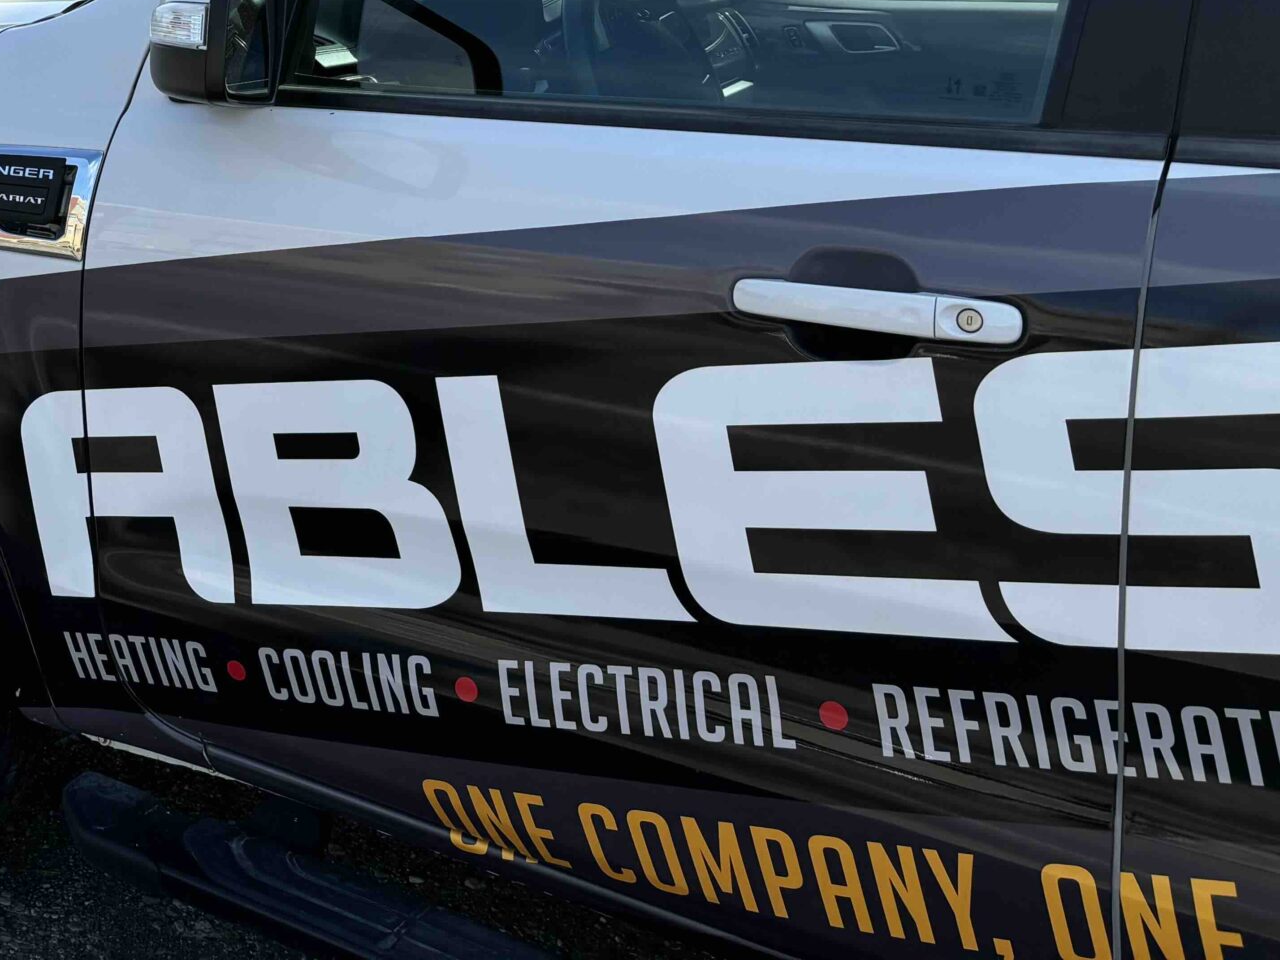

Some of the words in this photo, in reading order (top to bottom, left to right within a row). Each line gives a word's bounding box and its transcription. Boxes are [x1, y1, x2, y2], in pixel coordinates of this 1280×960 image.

[21, 342, 1280, 653] ABLES
[63, 631, 218, 693] HEATING
[257, 646, 439, 717] COOLING
[496, 659, 797, 749] ELECTRICAL
[422, 778, 572, 869] ONE
